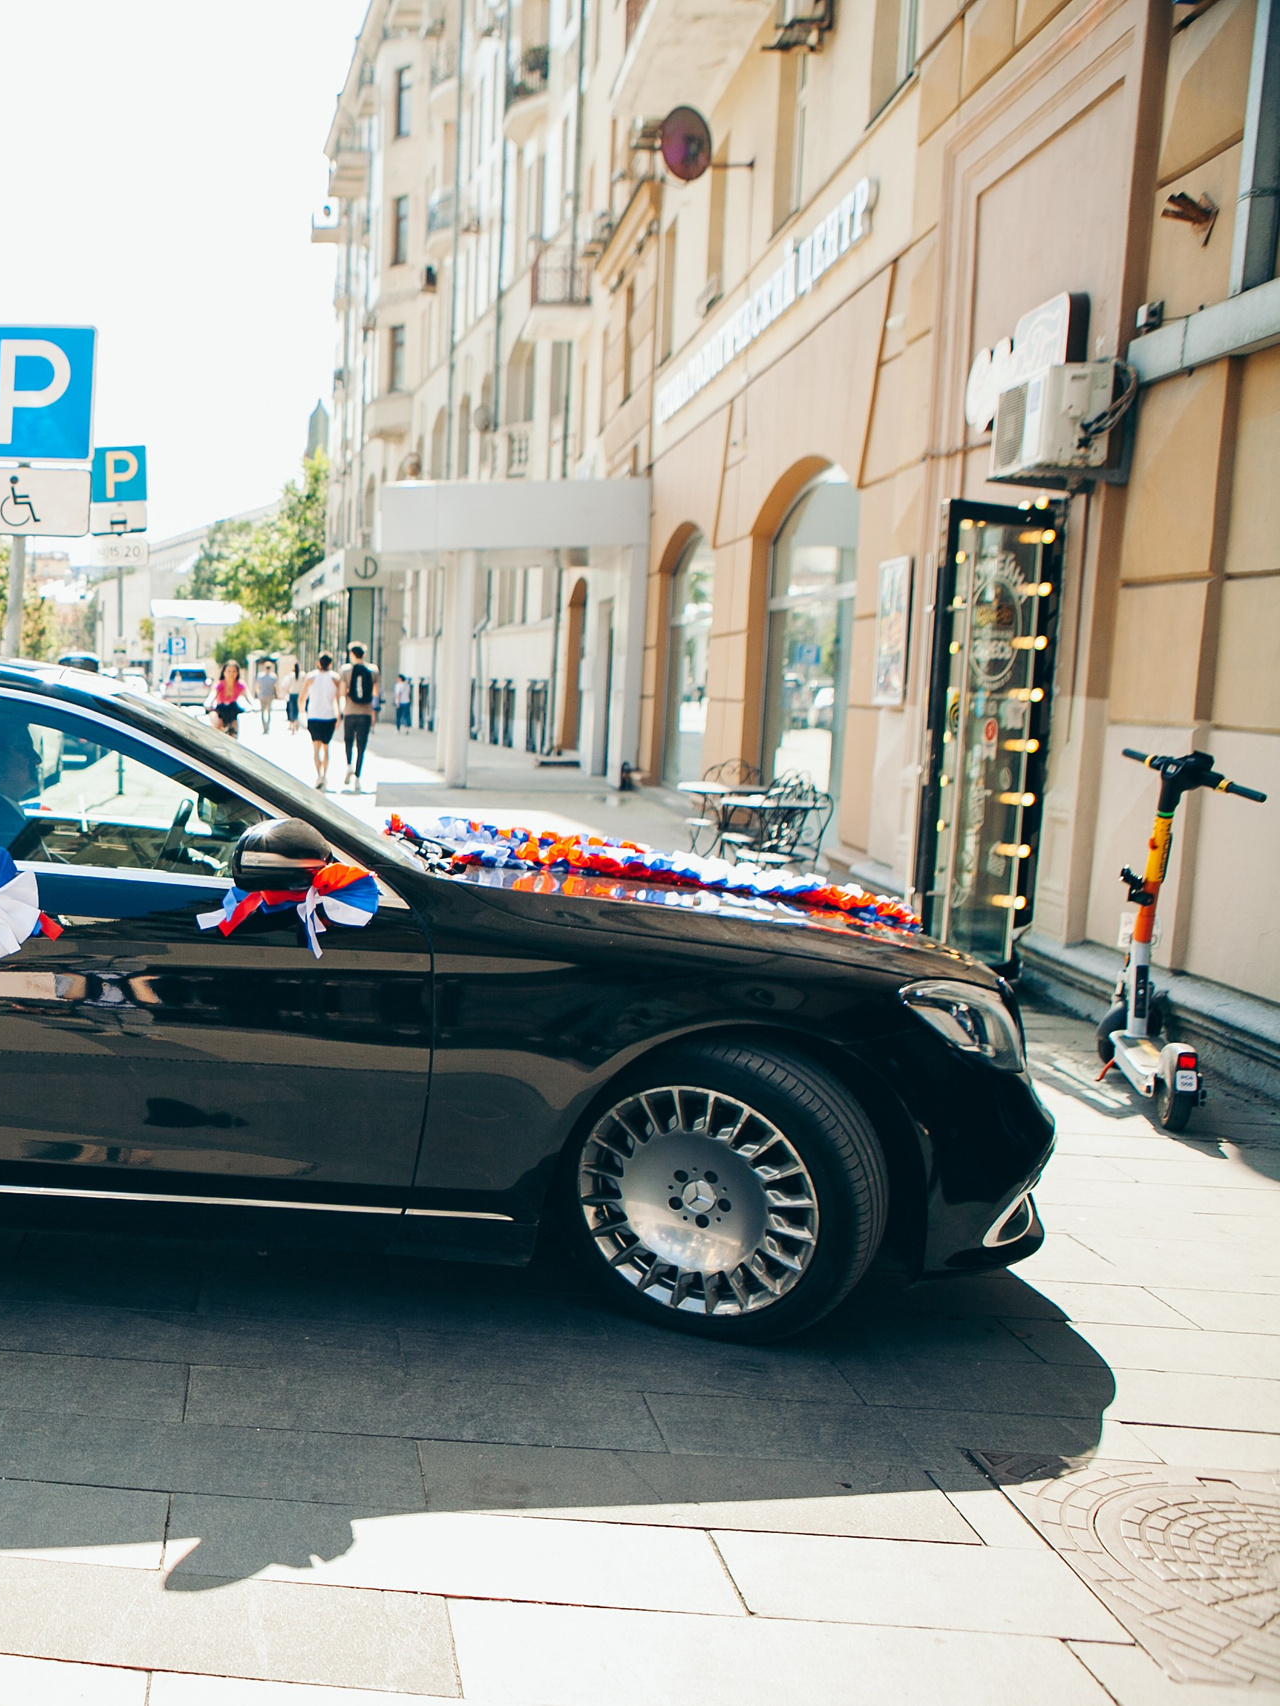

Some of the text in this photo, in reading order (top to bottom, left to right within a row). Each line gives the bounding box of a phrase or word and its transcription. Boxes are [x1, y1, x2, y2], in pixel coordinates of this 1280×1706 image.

[797, 176, 869, 296] ЦЕНТР
[105, 450, 138, 499] P
[109, 546, 120, 557] 15
[124, 545, 141, 558] 20
